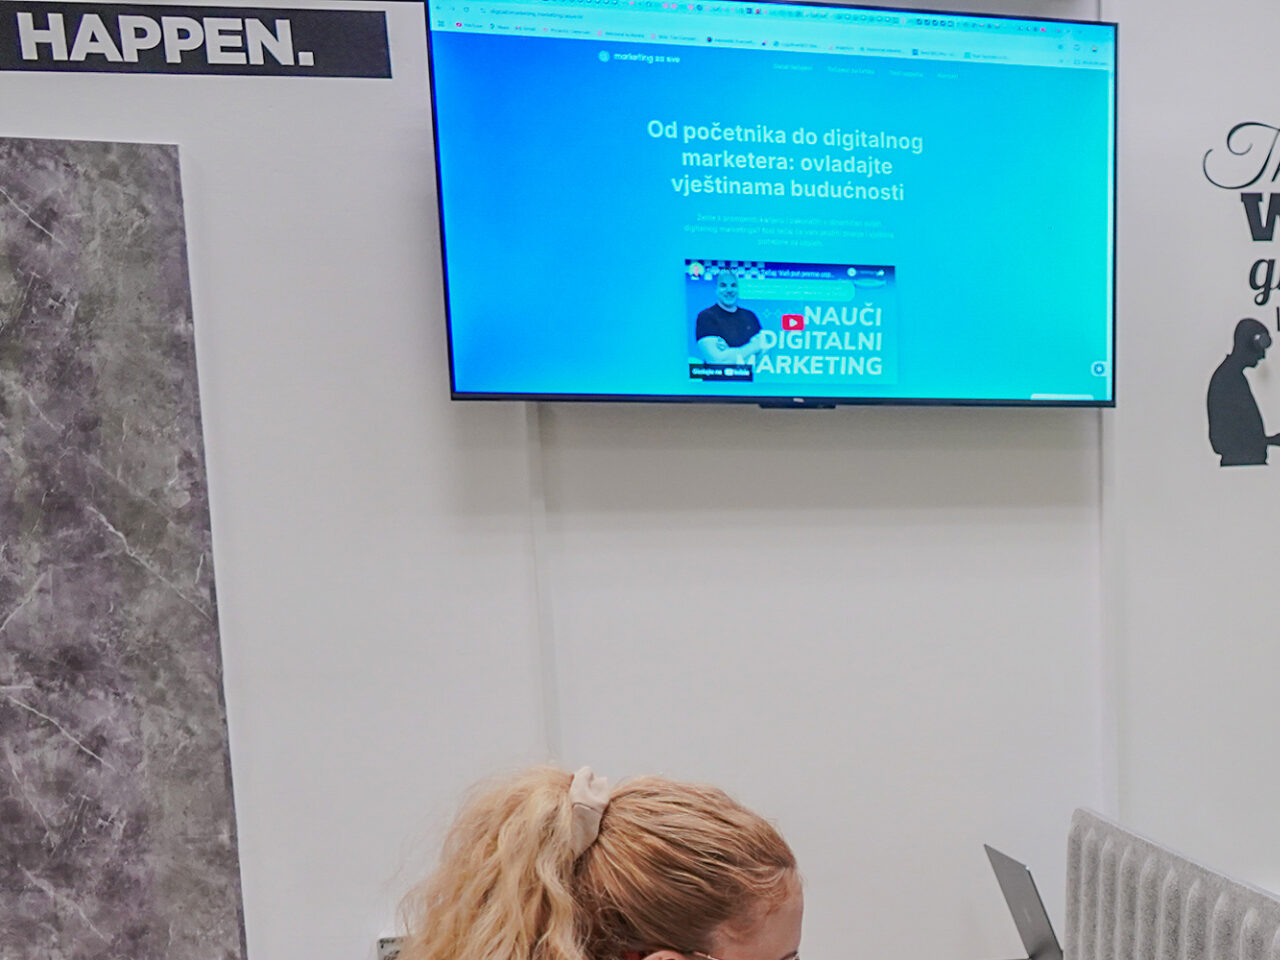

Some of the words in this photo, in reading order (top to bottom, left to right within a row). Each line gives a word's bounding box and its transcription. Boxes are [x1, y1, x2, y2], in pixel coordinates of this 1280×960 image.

[16, 11, 315, 67] HAPPEN.
[647, 120, 678, 139] Od
[683, 122, 787, 144] početnika
[792, 128, 818, 145] do
[823, 129, 924, 155] digitalnog
[682, 150, 795, 170] marketera:
[800, 155, 893, 178] ovladajte
[671, 174, 785, 197] vještinama
[791, 179, 905, 201] budućnosti
[803, 302, 882, 327] NAUČI
[761, 329, 882, 351] DIGITALNI
